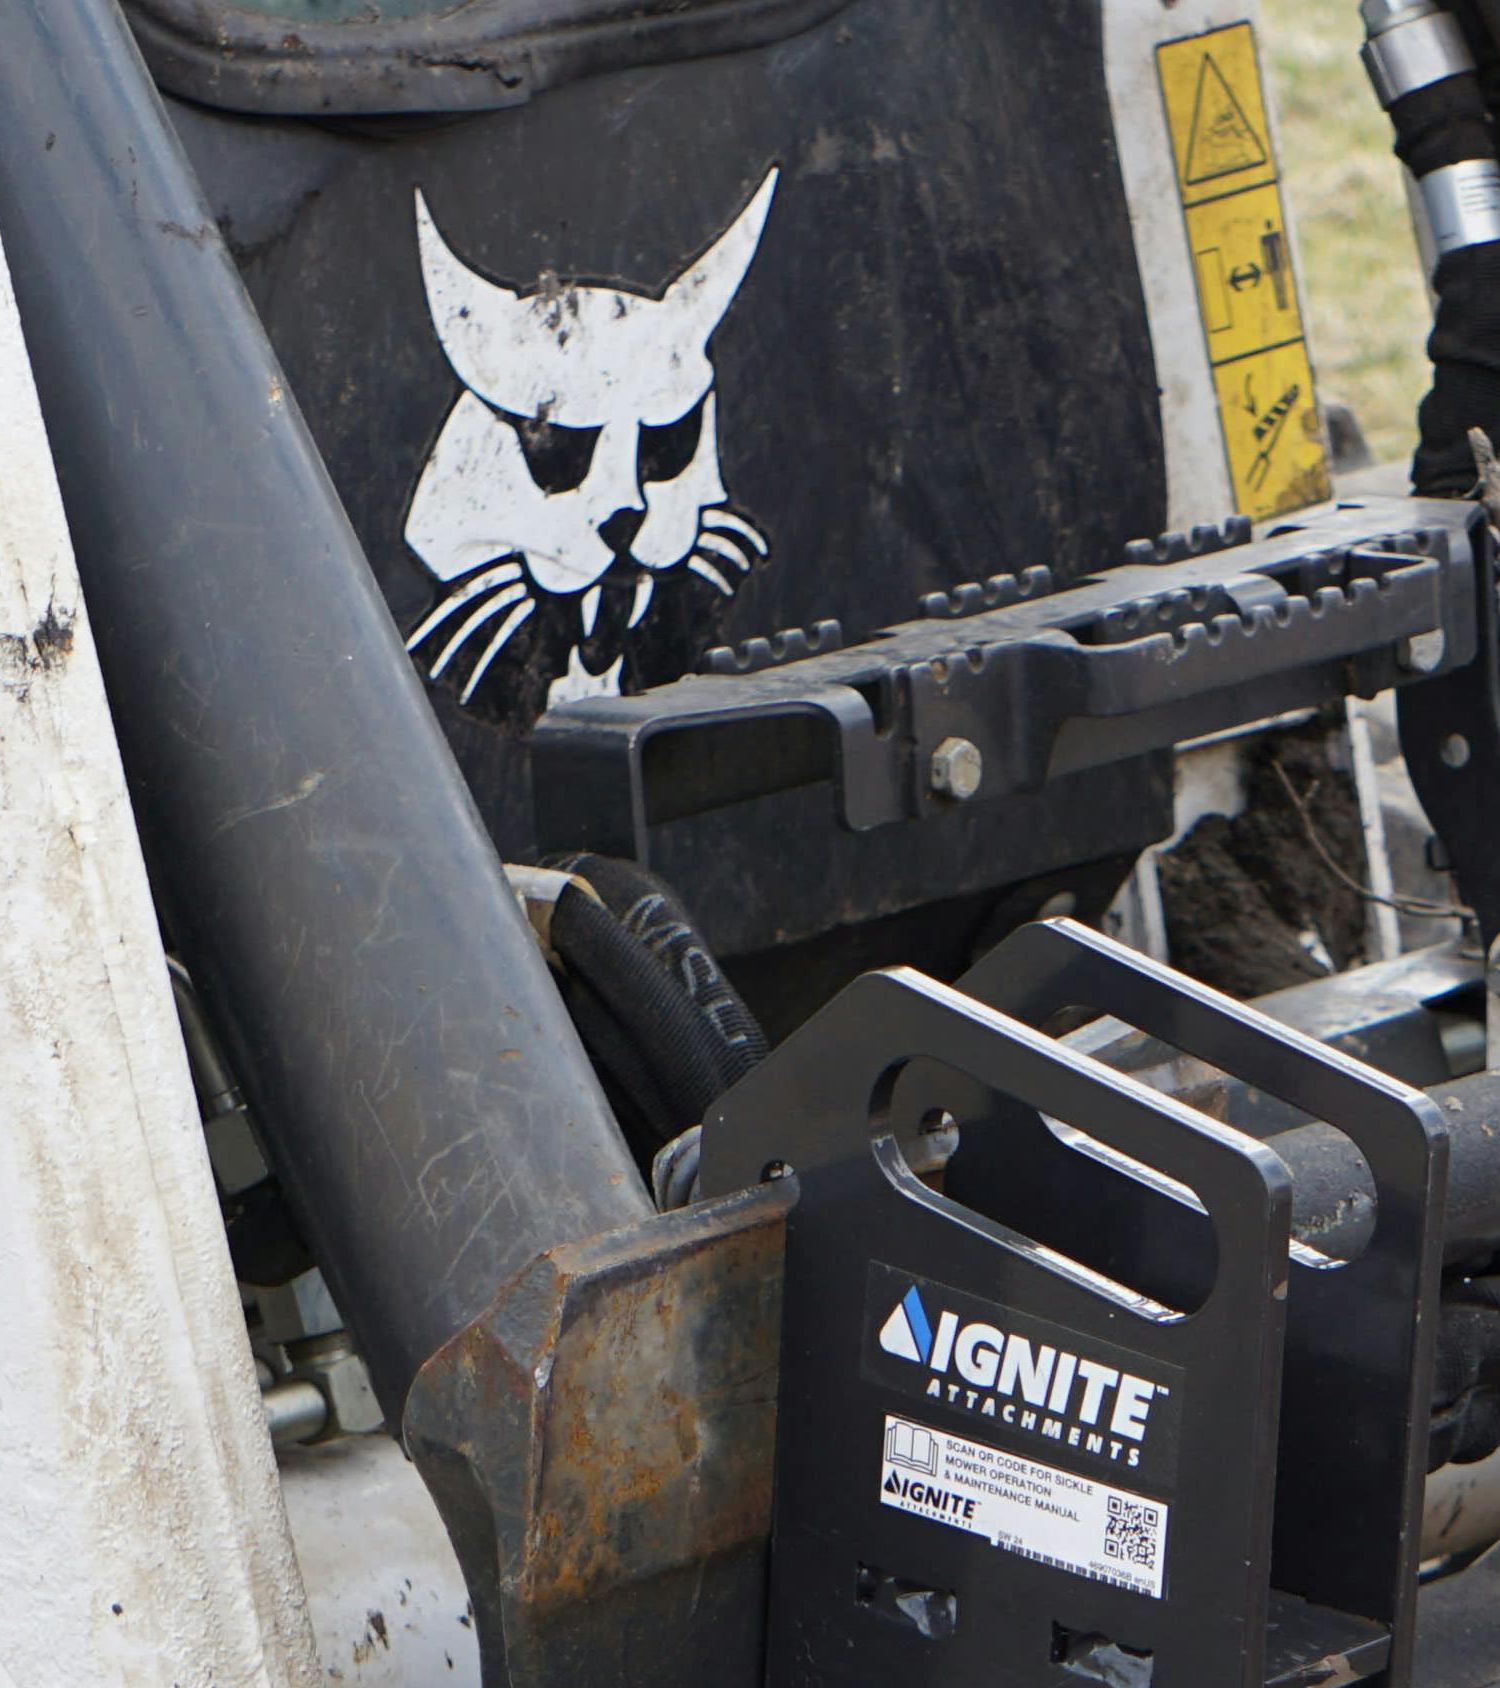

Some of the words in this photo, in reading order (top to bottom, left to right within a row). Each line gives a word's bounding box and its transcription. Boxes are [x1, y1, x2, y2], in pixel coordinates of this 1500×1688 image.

[930, 1310, 1156, 1442] IGNITE
[926, 1378, 1141, 1468] ATTACHMENTS
[945, 1454, 987, 1477] MOWER
[989, 1467, 1052, 1497] OPERATION
[946, 1439, 976, 1458] SCAN
[978, 1449, 994, 1464] QR
[996, 1456, 1028, 1474] CODE
[1030, 1466, 1052, 1482] FOR
[1055, 1474, 1093, 1496] SICKLE
[901, 1478, 976, 1519] IGNITE
[944, 1469, 951, 1480] &
[954, 1472, 1032, 1506] MAINTENANCE
[1034, 1499, 1080, 1522] MANUAL
